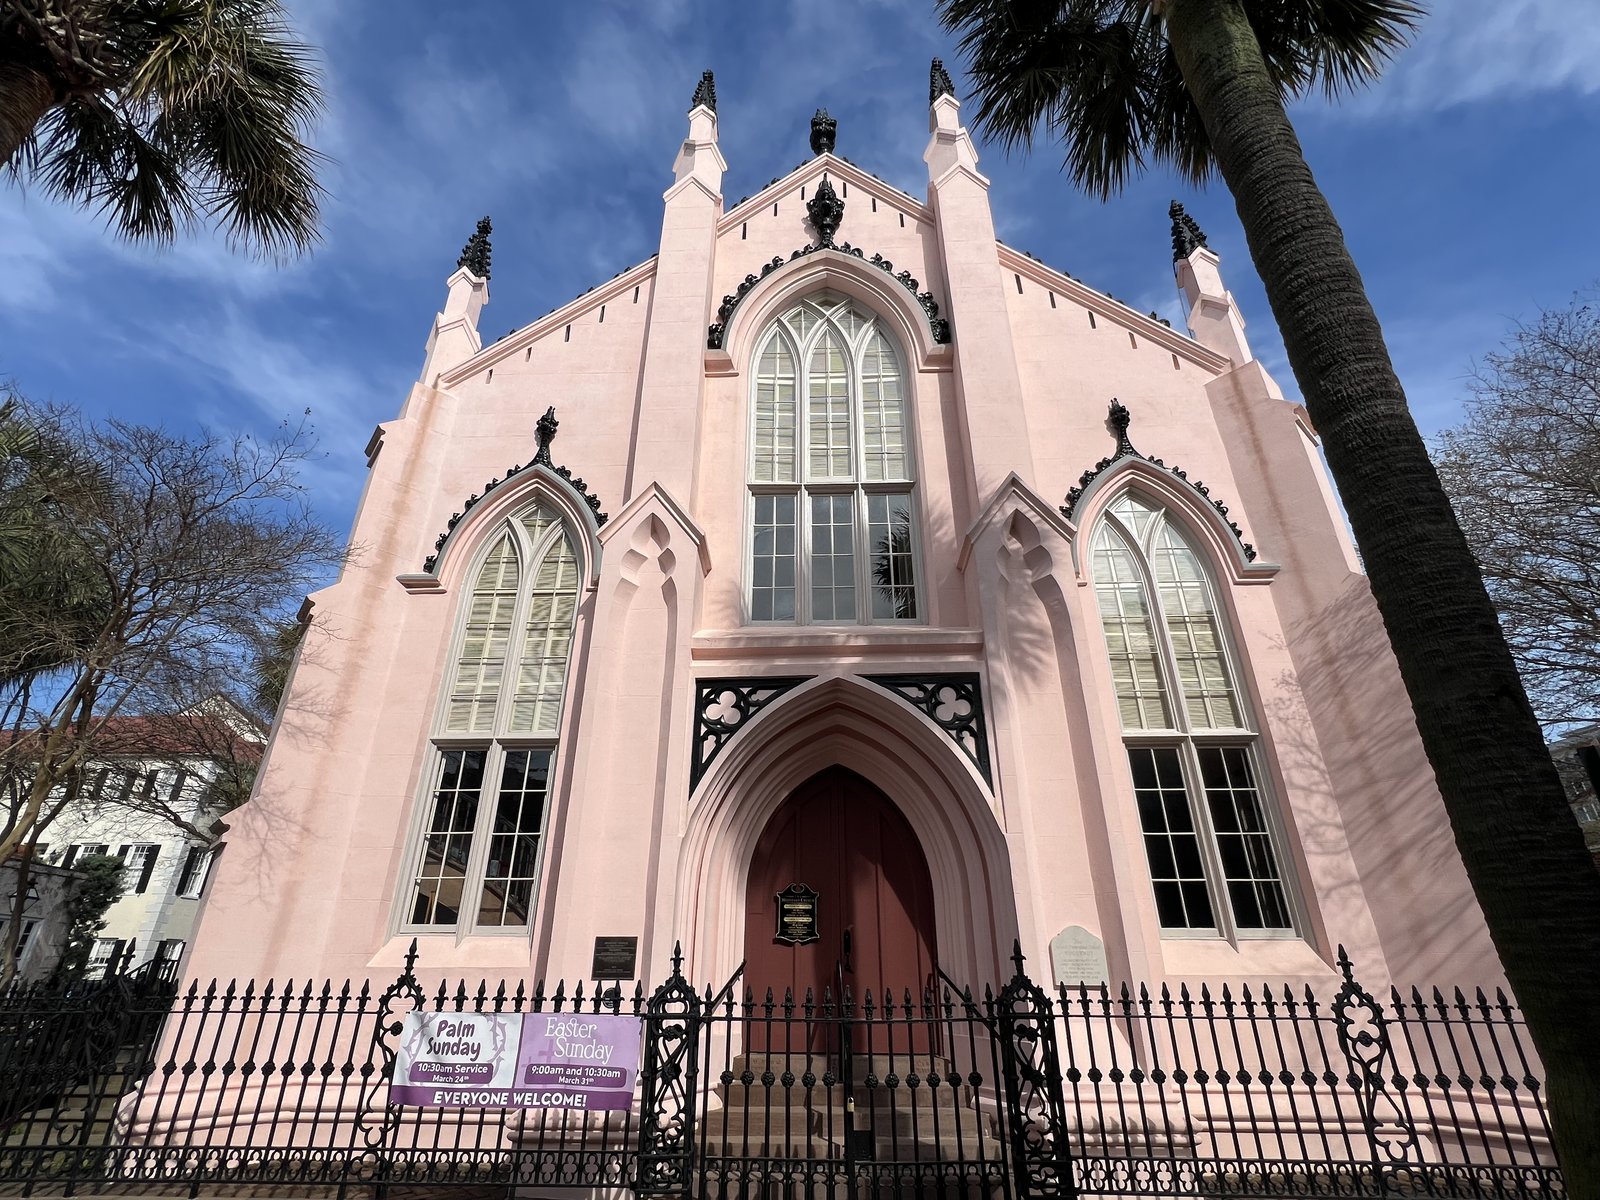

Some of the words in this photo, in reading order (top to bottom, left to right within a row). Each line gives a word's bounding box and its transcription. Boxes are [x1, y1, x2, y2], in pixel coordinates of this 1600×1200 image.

[437, 1020, 476, 1038] Palm
[545, 1017, 598, 1038] Easter
[426, 1037, 480, 1061] Sunday
[554, 1036, 614, 1065] Sunday
[418, 1063, 452, 1072] 10:30am
[454, 1064, 488, 1073] Service
[532, 1066, 564, 1075] 9:00am
[566, 1067, 582, 1076] and
[584, 1068, 620, 1078] 10:30am
[558, 1076, 580, 1084] March
[433, 1092, 508, 1105] EVERYONE
[513, 1092, 588, 1107] WELCOME!
